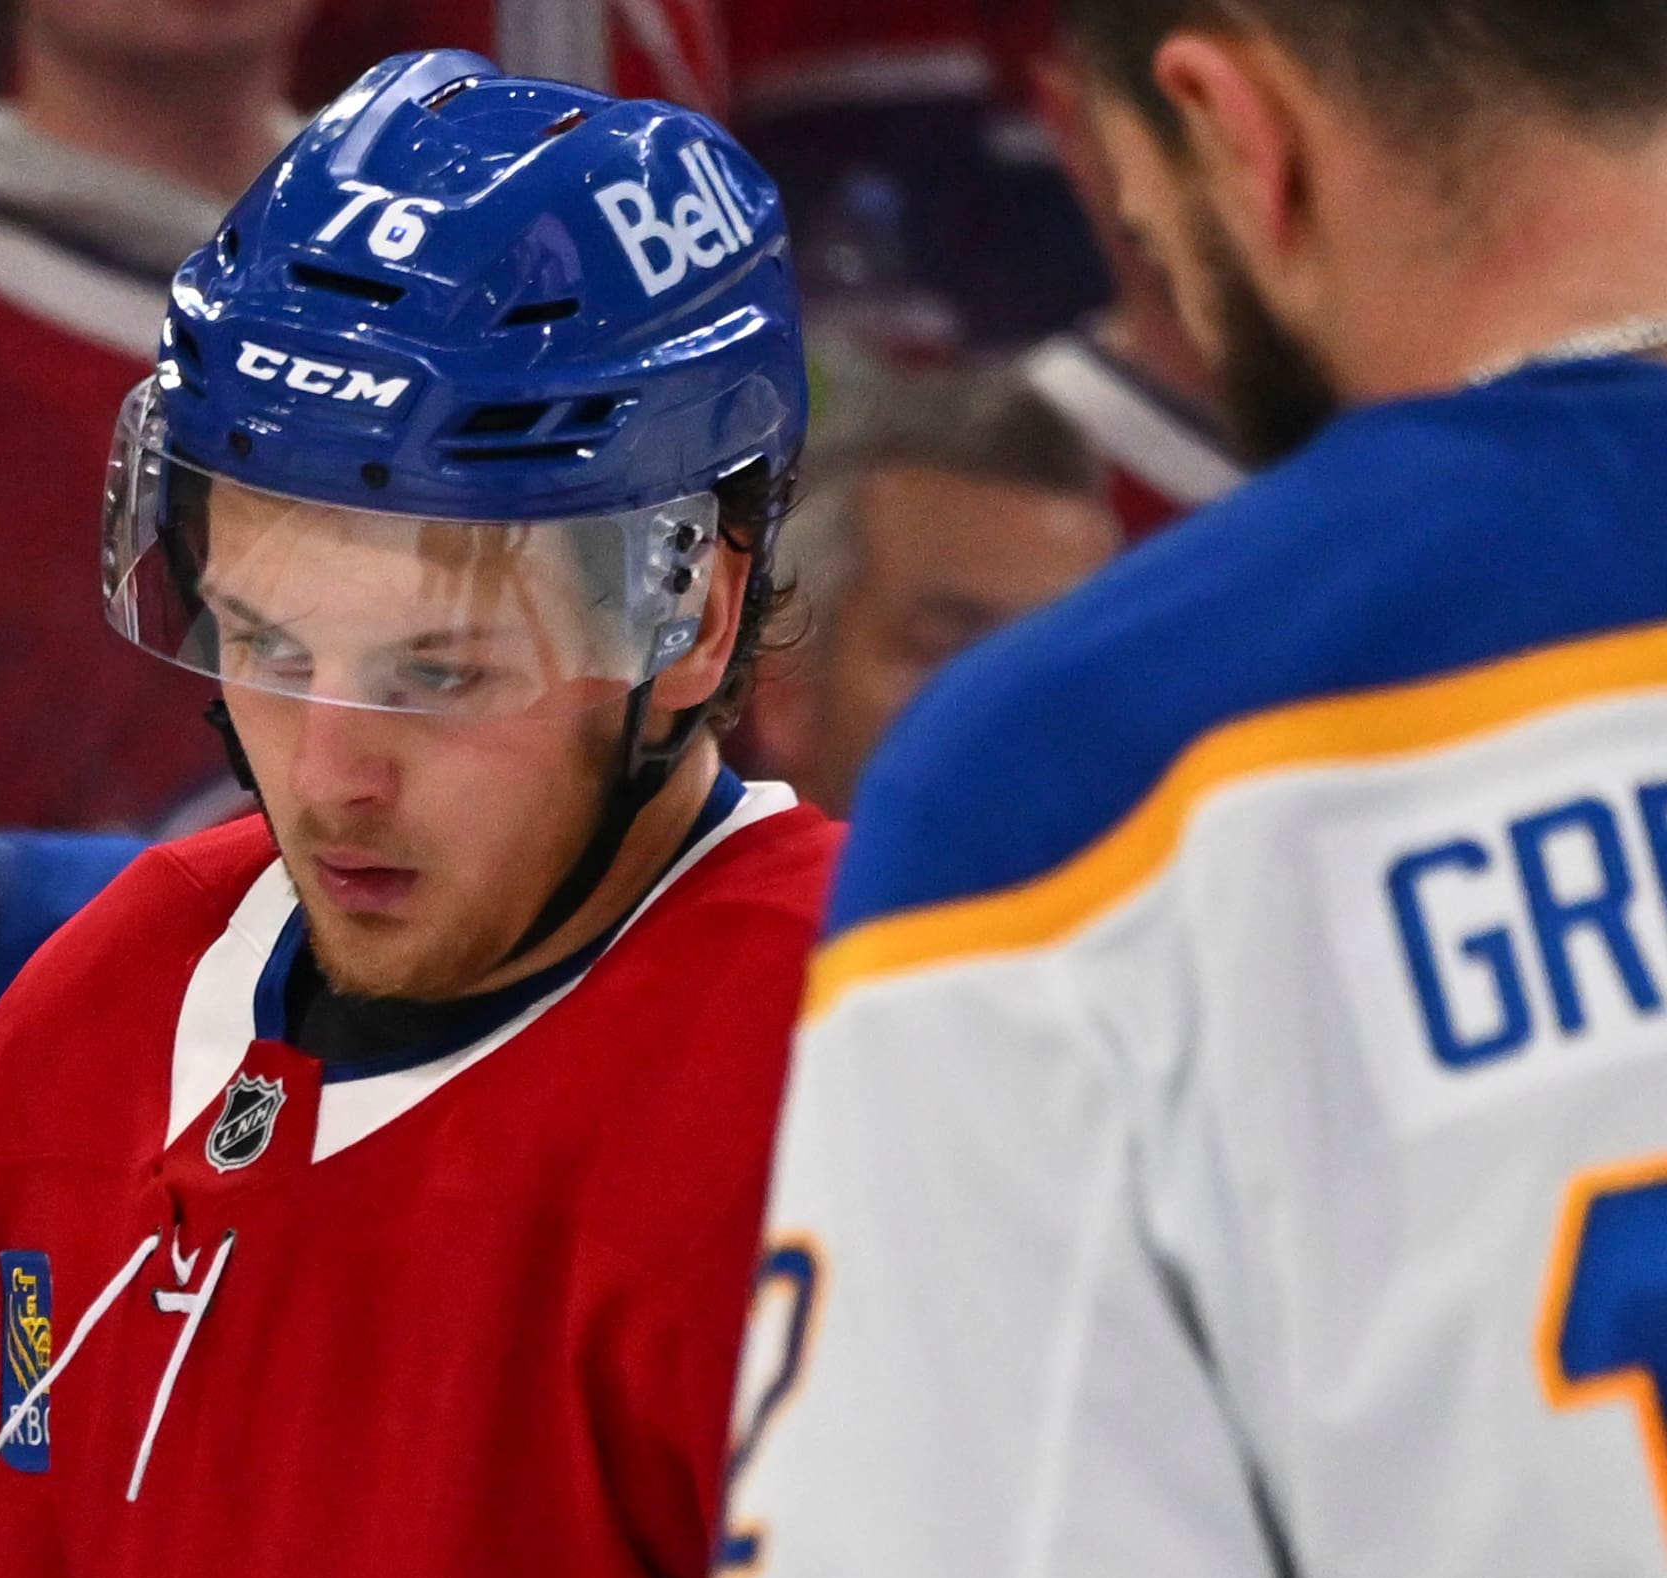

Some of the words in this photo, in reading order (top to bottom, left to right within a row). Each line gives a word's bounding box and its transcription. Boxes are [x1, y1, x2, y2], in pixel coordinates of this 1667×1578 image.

[315, 180, 445, 261] 76
[594, 140, 754, 297] Bell
[235, 340, 411, 408] CCM
[1383, 778, 1667, 1074] GR
